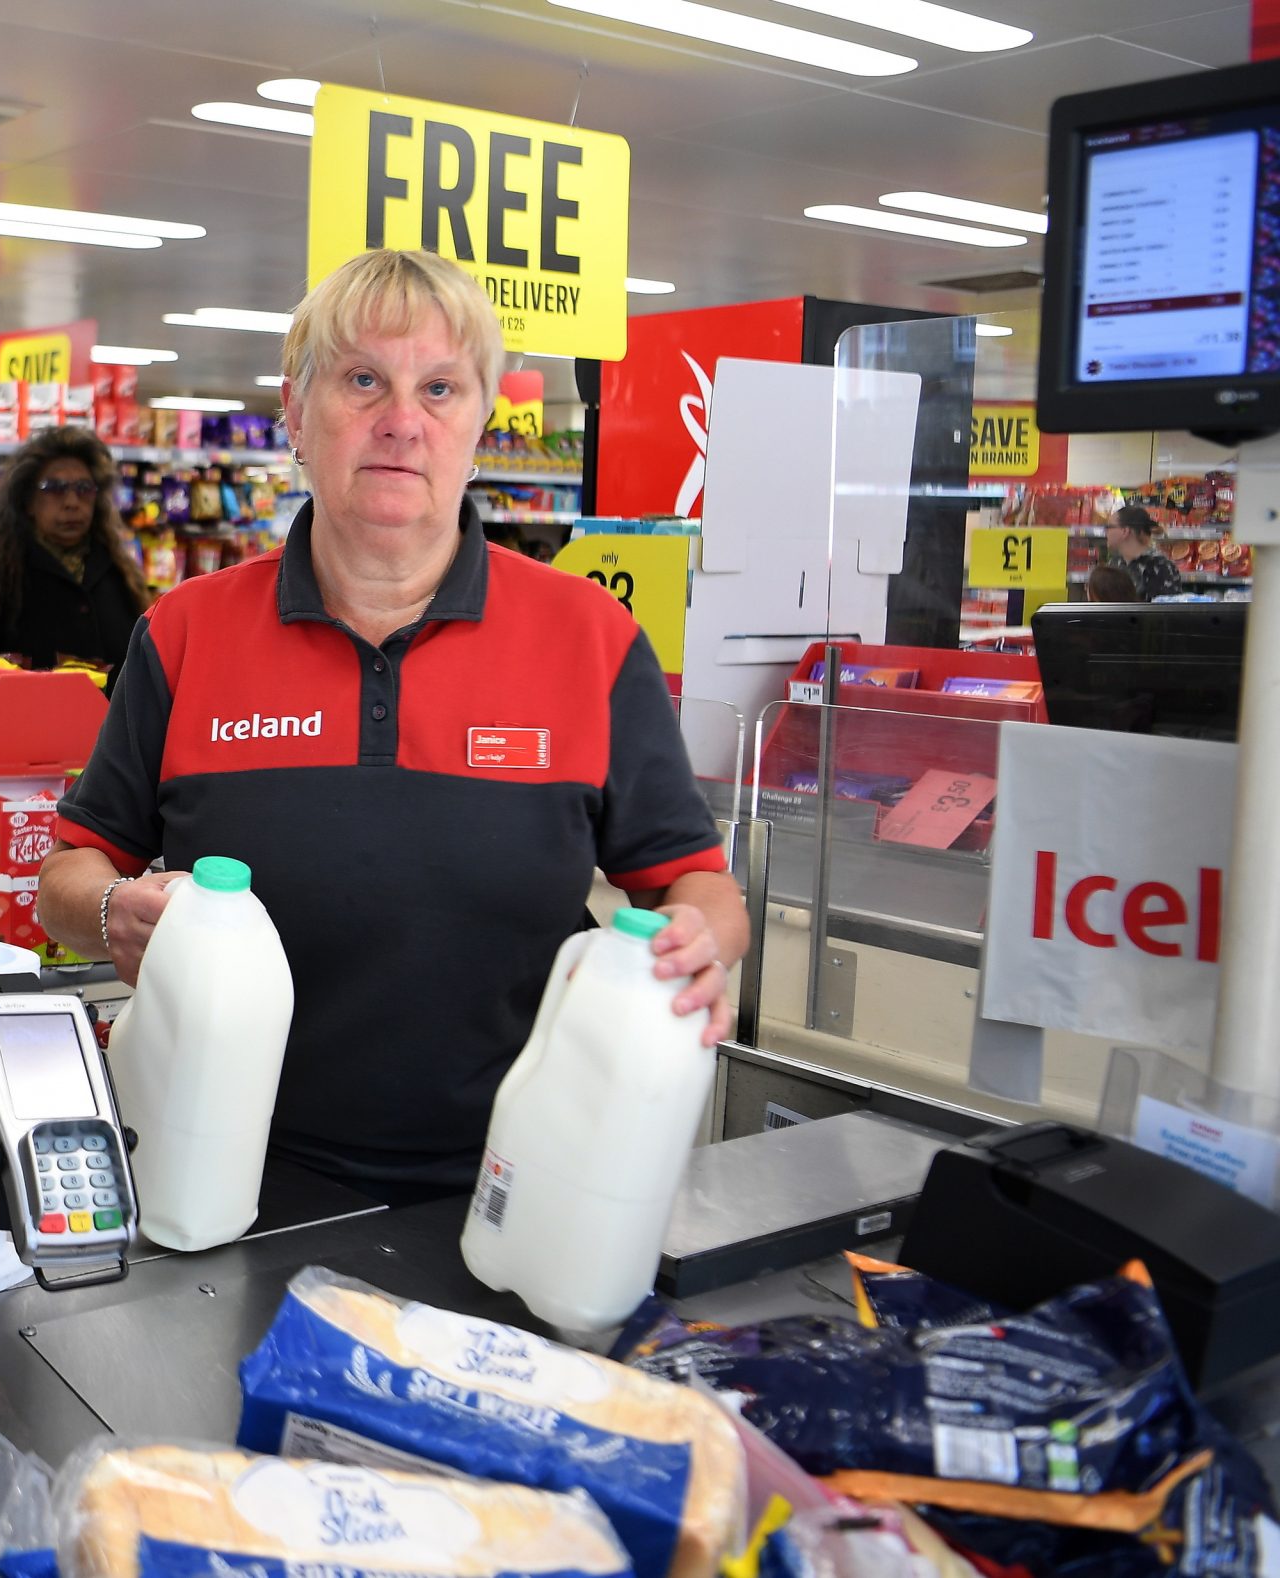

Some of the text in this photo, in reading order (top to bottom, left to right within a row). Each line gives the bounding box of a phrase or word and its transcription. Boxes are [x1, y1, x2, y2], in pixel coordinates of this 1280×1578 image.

[366, 110, 583, 275] FREE
[486, 276, 581, 315] DELIVERY
[507, 317, 526, 332] £25
[8, 350, 61, 384] SAVE
[970, 416, 1030, 448] SAVE
[970, 451, 1028, 466] N BRANDS
[601, 551, 619, 567] only
[1002, 534, 1033, 572] £1
[586, 570, 635, 617] 3
[211, 710, 322, 742] Iceland
[475, 734, 507, 745] Janice
[536, 732, 547, 765] Iceland
[761, 791, 793, 803] Challenge
[14, 834, 51, 863] KitKat
[26, 879, 36, 887] 10
[1032, 850, 1223, 963] Icel
[63, 1140, 69, 1149] 2
[91, 1138, 98, 1146] 3
